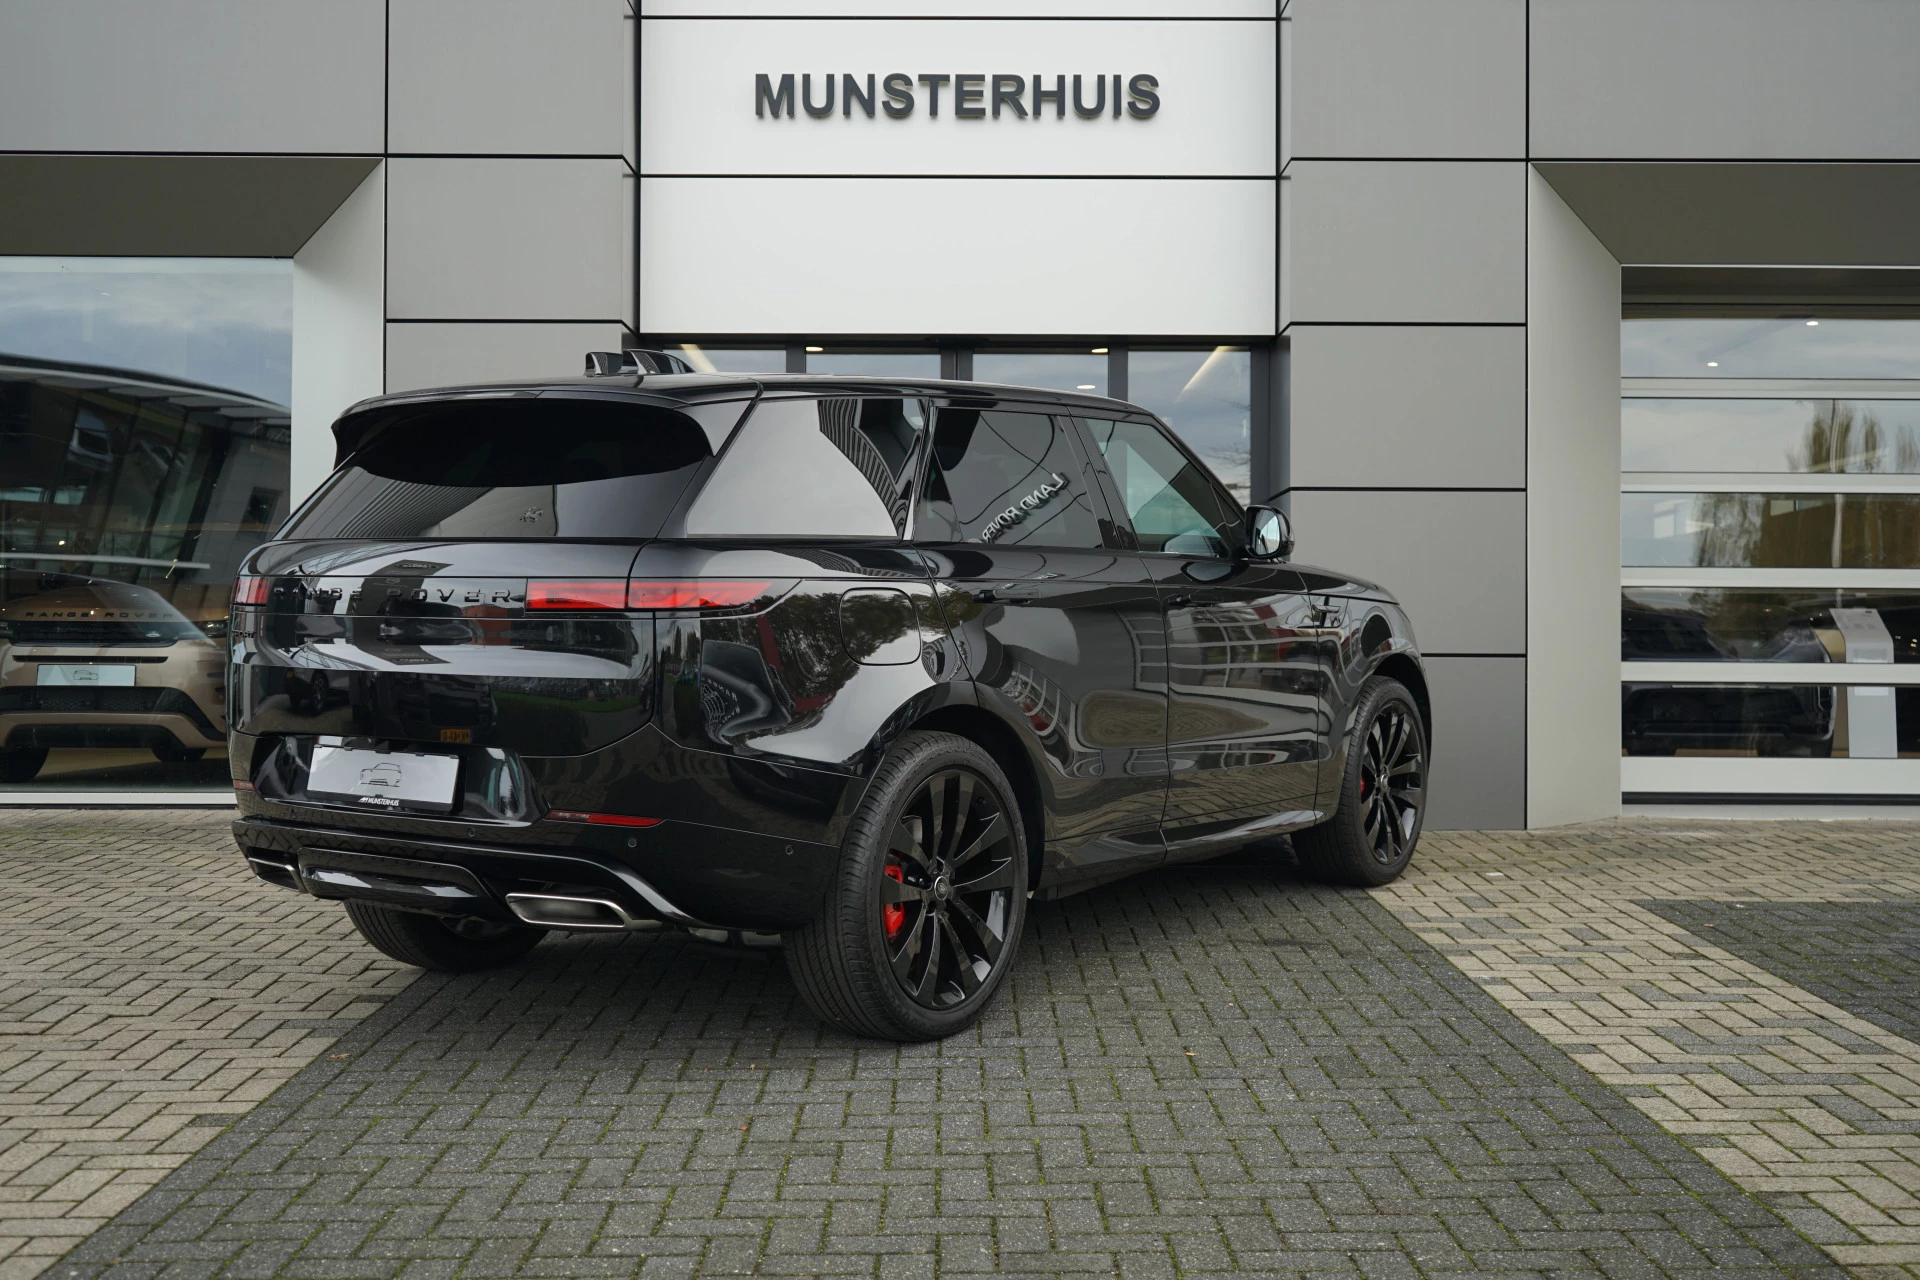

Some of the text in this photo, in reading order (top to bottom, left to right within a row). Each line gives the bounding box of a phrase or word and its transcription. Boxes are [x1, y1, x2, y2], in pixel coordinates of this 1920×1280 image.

[755, 73, 1161, 118] MUNSTERHUIS
[385, 588, 511, 602] ROVER
[104, 611, 174, 619] ROVER
